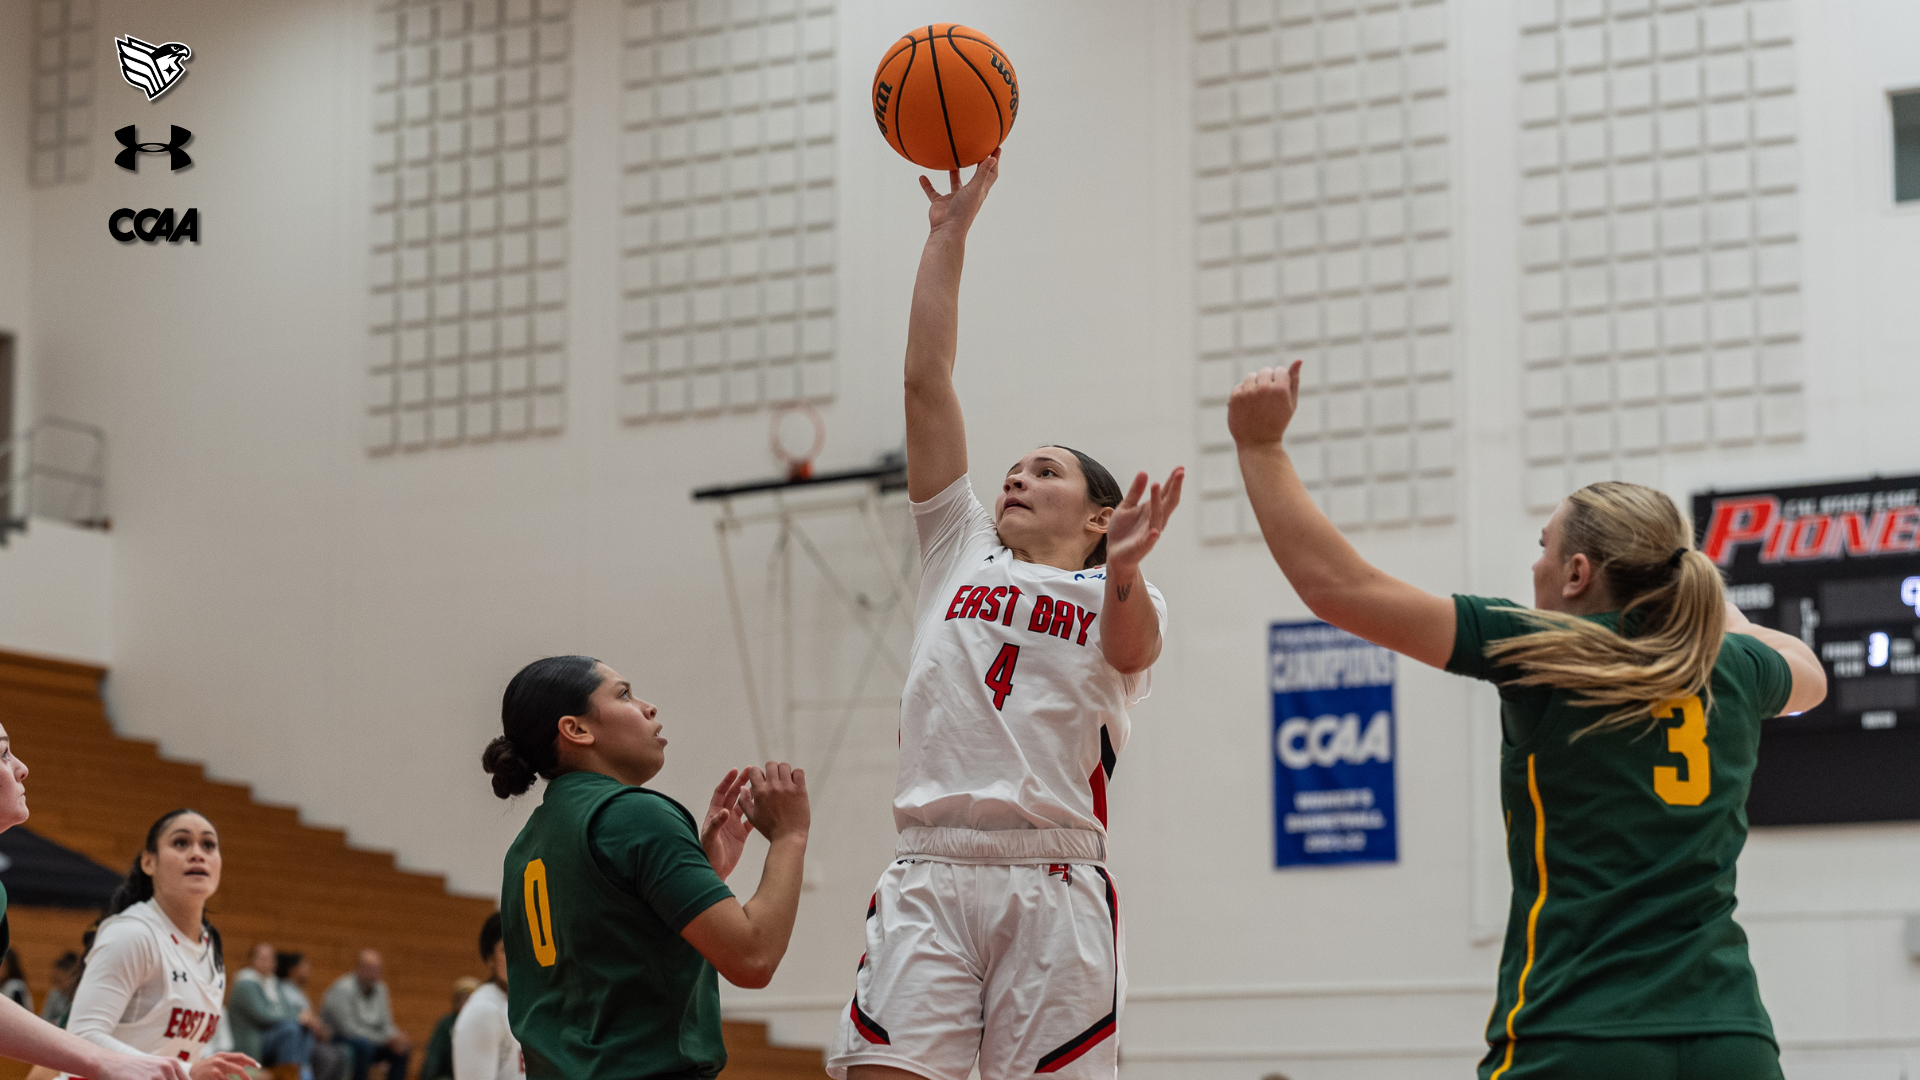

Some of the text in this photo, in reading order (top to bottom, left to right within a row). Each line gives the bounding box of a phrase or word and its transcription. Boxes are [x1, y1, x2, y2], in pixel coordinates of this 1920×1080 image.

[1701, 495, 1920, 565] PIONE
[944, 585, 1097, 647] EAST BAY
[984, 642, 1020, 712] 4
[1277, 711, 1391, 769] CCAA
[1651, 688, 1711, 807] 3
[524, 858, 557, 967] 0
